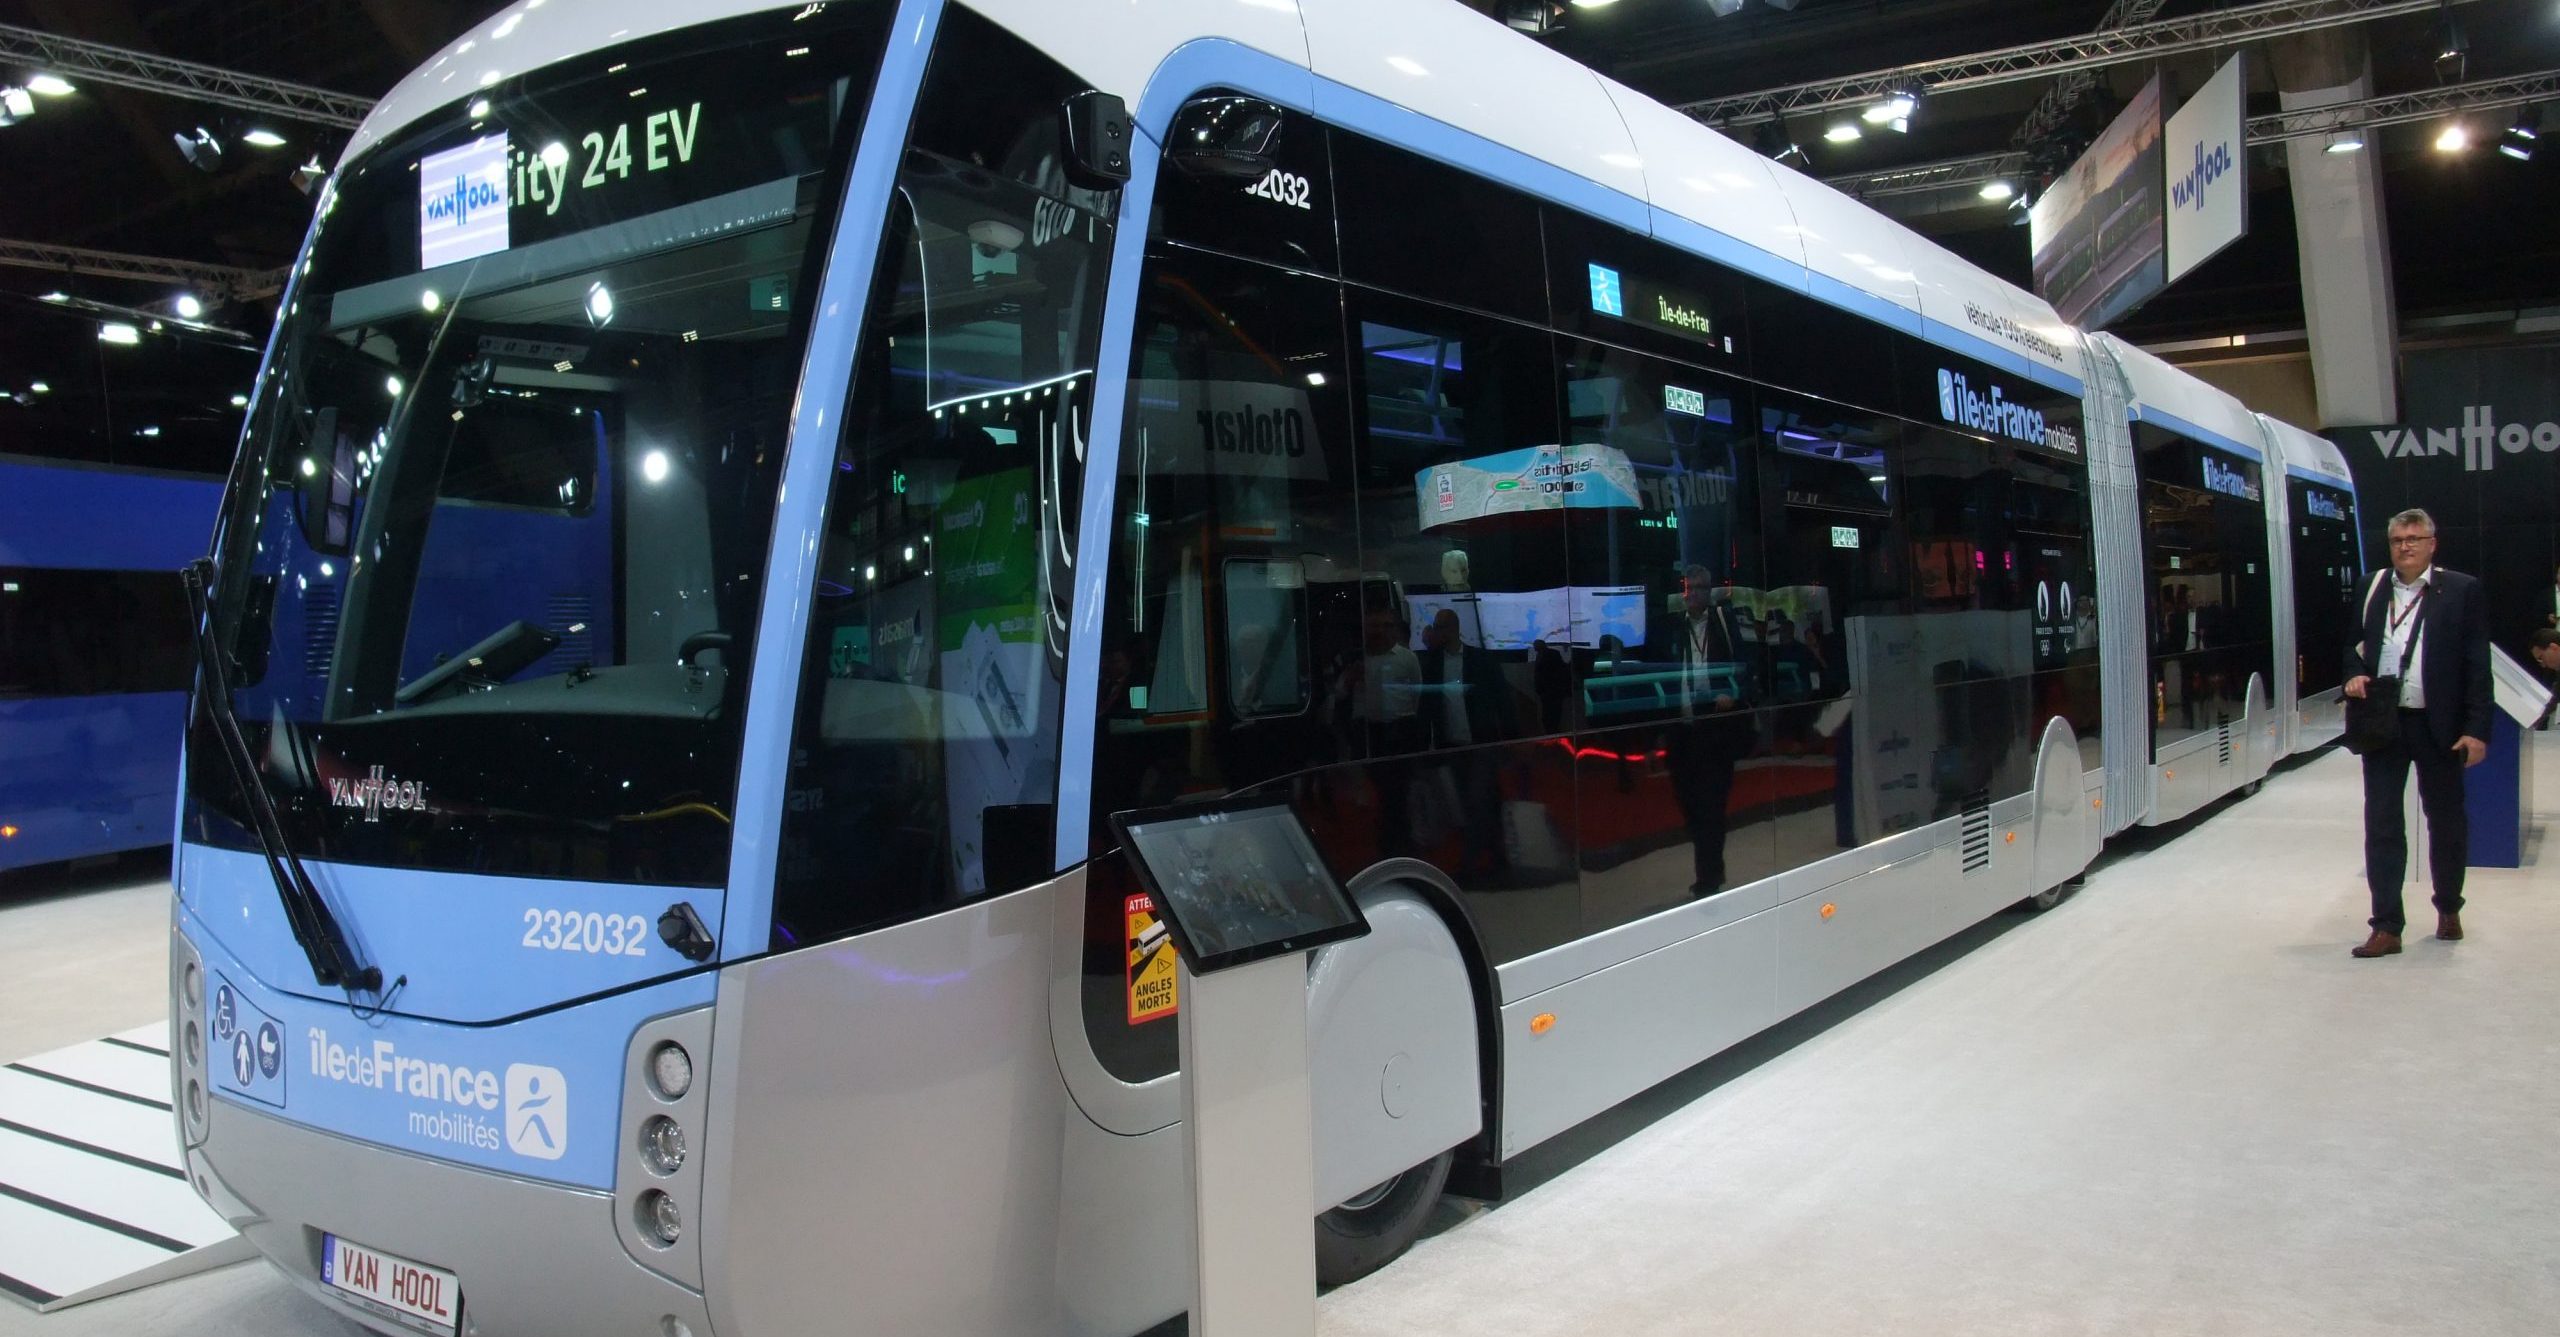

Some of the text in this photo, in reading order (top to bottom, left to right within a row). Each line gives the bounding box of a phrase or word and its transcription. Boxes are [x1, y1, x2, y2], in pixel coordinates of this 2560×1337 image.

[507, 102, 701, 216] ity 24 EV
[522, 908, 647, 957] 232032
[1135, 976, 1173, 999] ANGLES
[1137, 992, 1171, 1012] MORTS
[409, 1108, 501, 1151] mobilités
[324, 1262, 333, 1278] B
[343, 1246, 379, 1293] VAN
[392, 1263, 448, 1317] HOOL
